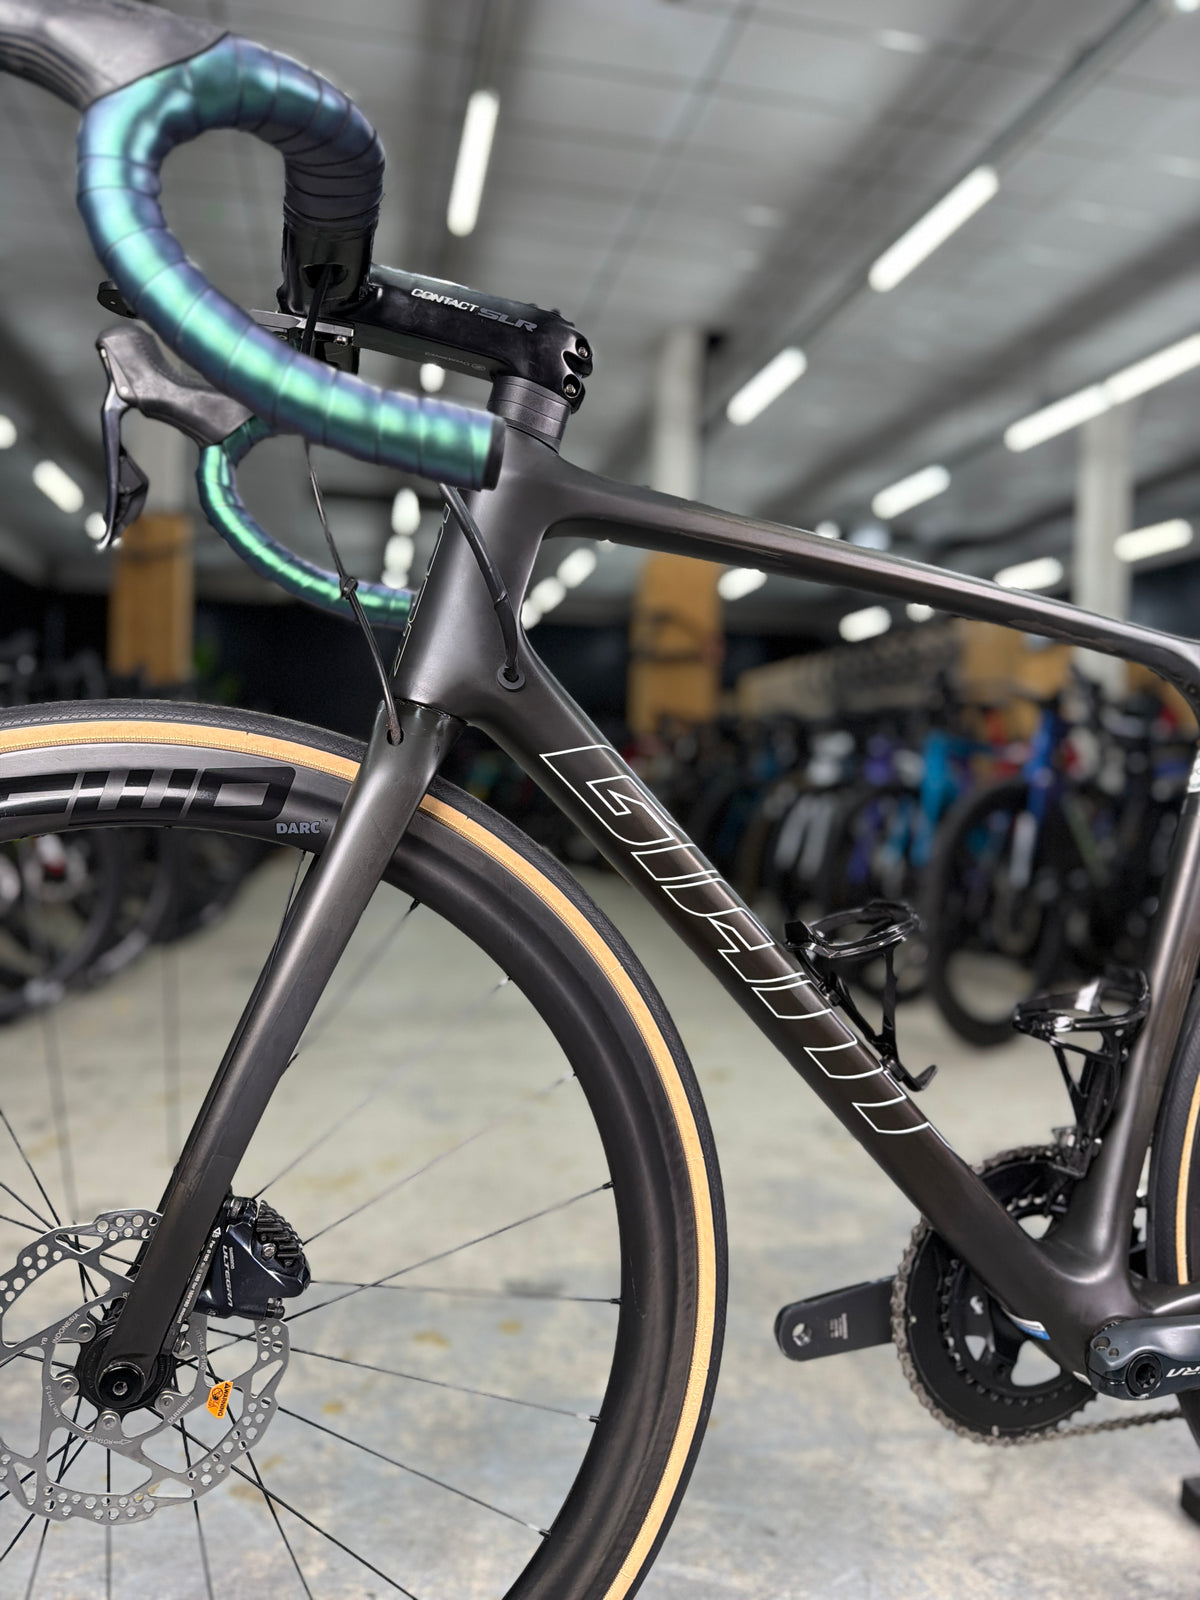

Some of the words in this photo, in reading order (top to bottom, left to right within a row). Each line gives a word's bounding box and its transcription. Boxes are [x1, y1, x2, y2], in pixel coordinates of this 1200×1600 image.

[411, 288, 479, 312] CONTACT
[478, 307, 538, 333] SLR
[539, 744, 946, 1147] GIANT
[222, 1245, 234, 1307] ULTEGRA
[53, 1312, 80, 1344] INDONESIA
